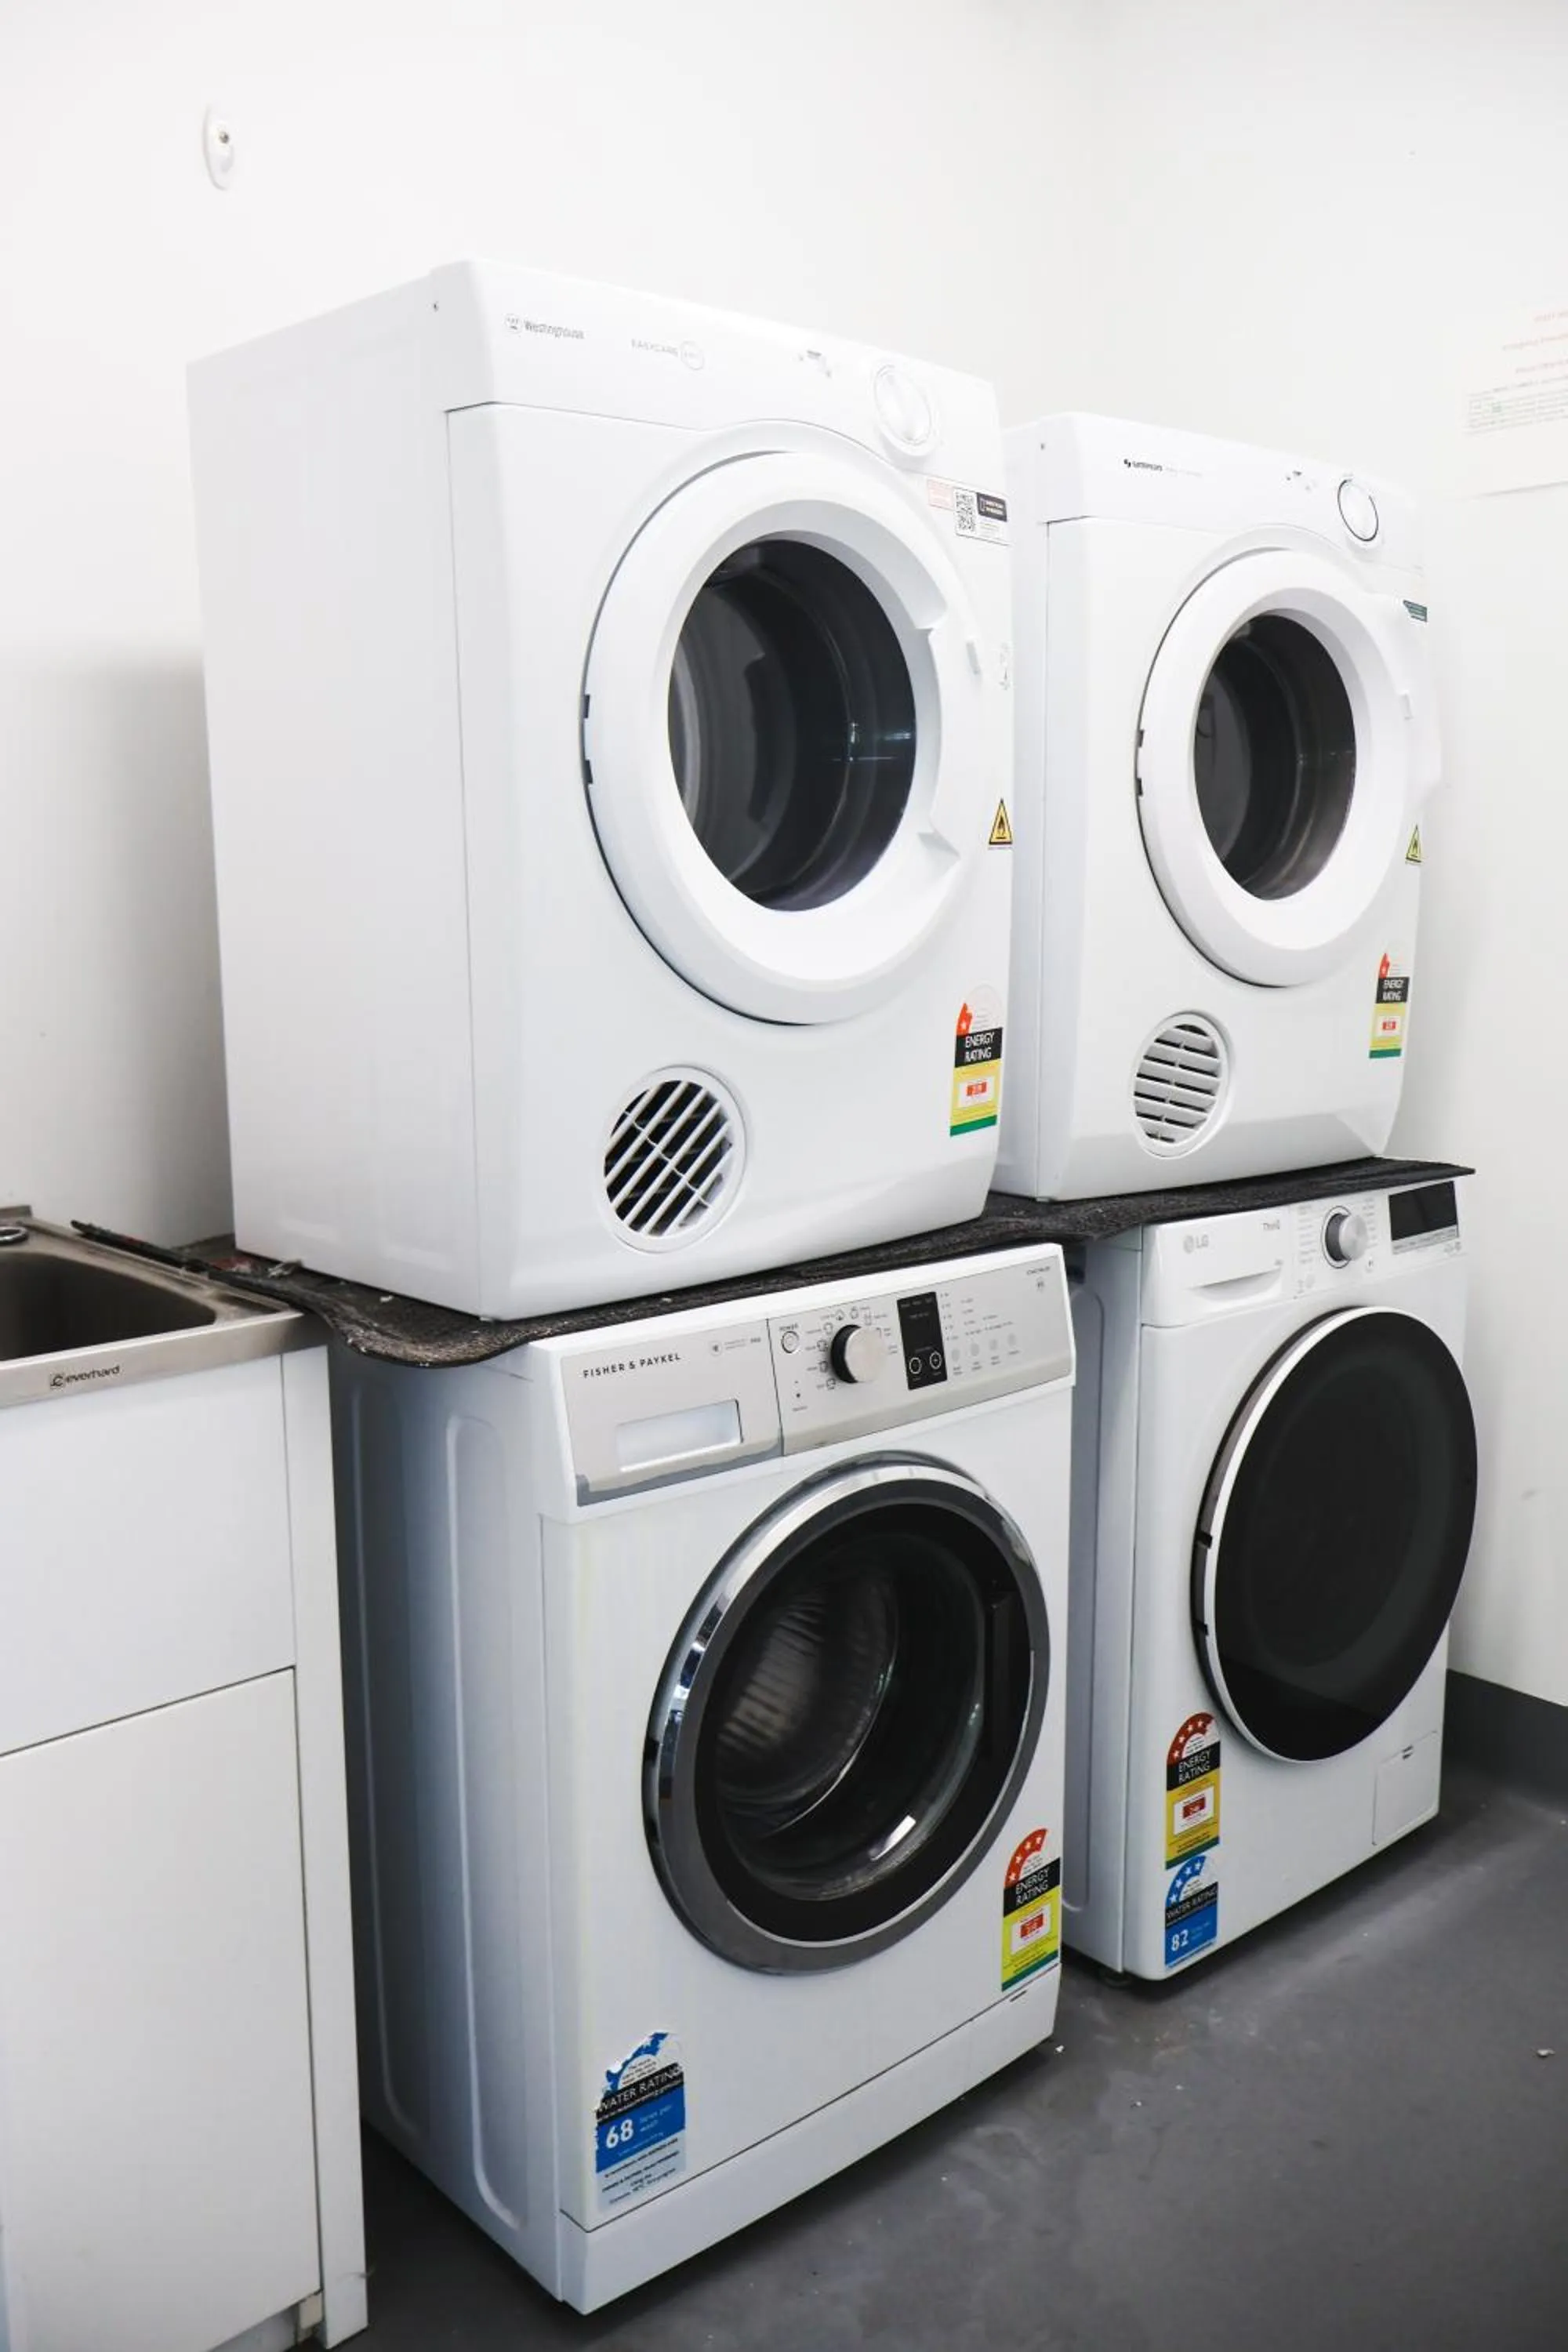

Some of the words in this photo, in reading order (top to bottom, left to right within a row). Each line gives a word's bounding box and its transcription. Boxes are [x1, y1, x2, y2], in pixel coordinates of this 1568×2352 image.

[524, 320, 586, 339] Westinghouse
[965, 1032, 995, 1048] ENERGY
[964, 1047, 992, 1063] RATING
[1195, 1234, 1210, 1249] LG
[65, 1365, 120, 1383] everhard
[583, 1363, 625, 1379] FISHER
[639, 1352, 682, 1369] PAYKEL
[1179, 1748, 1211, 1773] ENERGY
[1178, 1761, 1210, 1785] RATING
[1015, 1867, 1050, 1895] ENERGY
[1015, 1880, 1048, 1906] RATING
[1171, 1929, 1189, 1951] 82
[605, 2118, 634, 2149] 68
